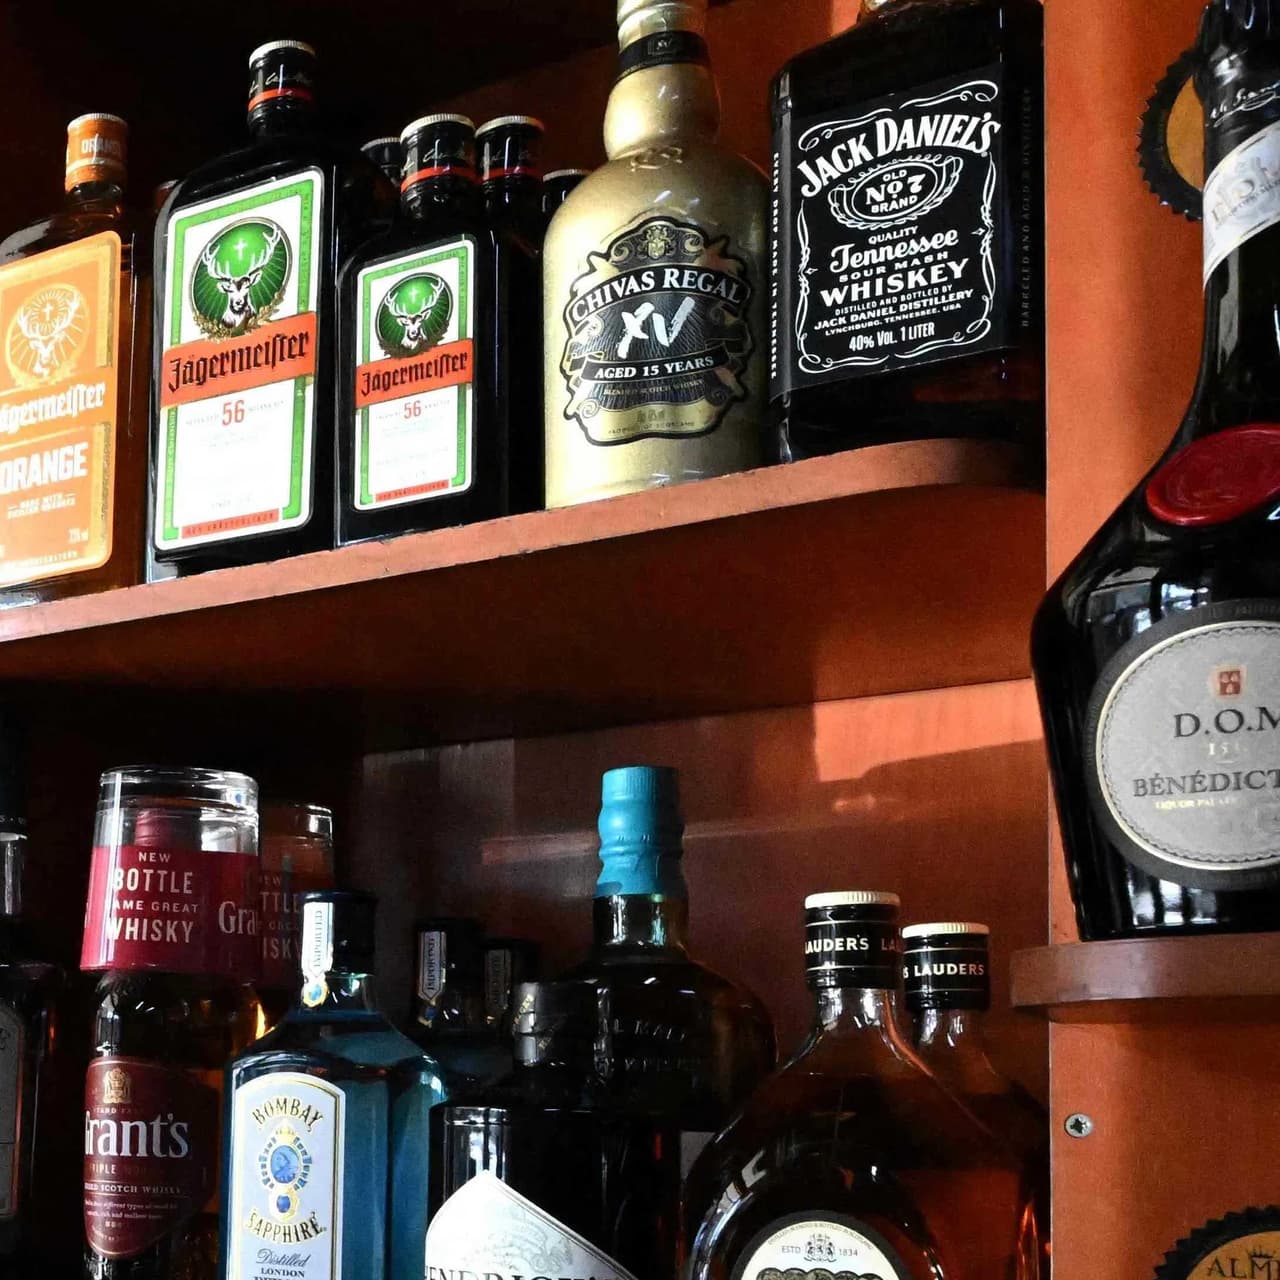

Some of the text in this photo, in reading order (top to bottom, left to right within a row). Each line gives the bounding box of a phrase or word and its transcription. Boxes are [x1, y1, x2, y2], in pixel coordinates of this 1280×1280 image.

[797, 112, 1001, 197] JACK DANIEL'S
[883, 169, 907, 182] OLD
[871, 195, 918, 214] BRAND
[868, 226, 918, 245] QUALITY
[830, 229, 959, 274] Tennessee
[839, 251, 949, 283] SOUR MASH
[572, 267, 740, 322] CHIVAS REGAL
[819, 258, 969, 308] WHISKEY
[814, 289, 974, 331] JACK DANIEL DISTILLERY
[835, 284, 953, 316] DISTILLED AND BOTTLED BY
[942, 302, 962, 312] USA
[617, 296, 696, 359] XV
[849, 331, 875, 352] 40%
[907, 323, 935, 341] LITER
[594, 356, 714, 379] AGED 15 YEARS
[222, 399, 246, 427] 56
[404, 400, 422, 419] 56
[139, 851, 172, 863] NEW
[114, 867, 194, 895] BOTTLE
[151, 901, 200, 914] GREAT
[107, 916, 194, 944] WHISKY
[914, 961, 985, 977] LAUDER'S
[252, 1096, 324, 1133] BOMBAY
[249, 1211, 325, 1244] SAPPHIRE
[256, 1248, 310, 1268] Distilled
[781, 1245, 801, 1255] ESTD
[261, 1267, 305, 1278] LONDON
